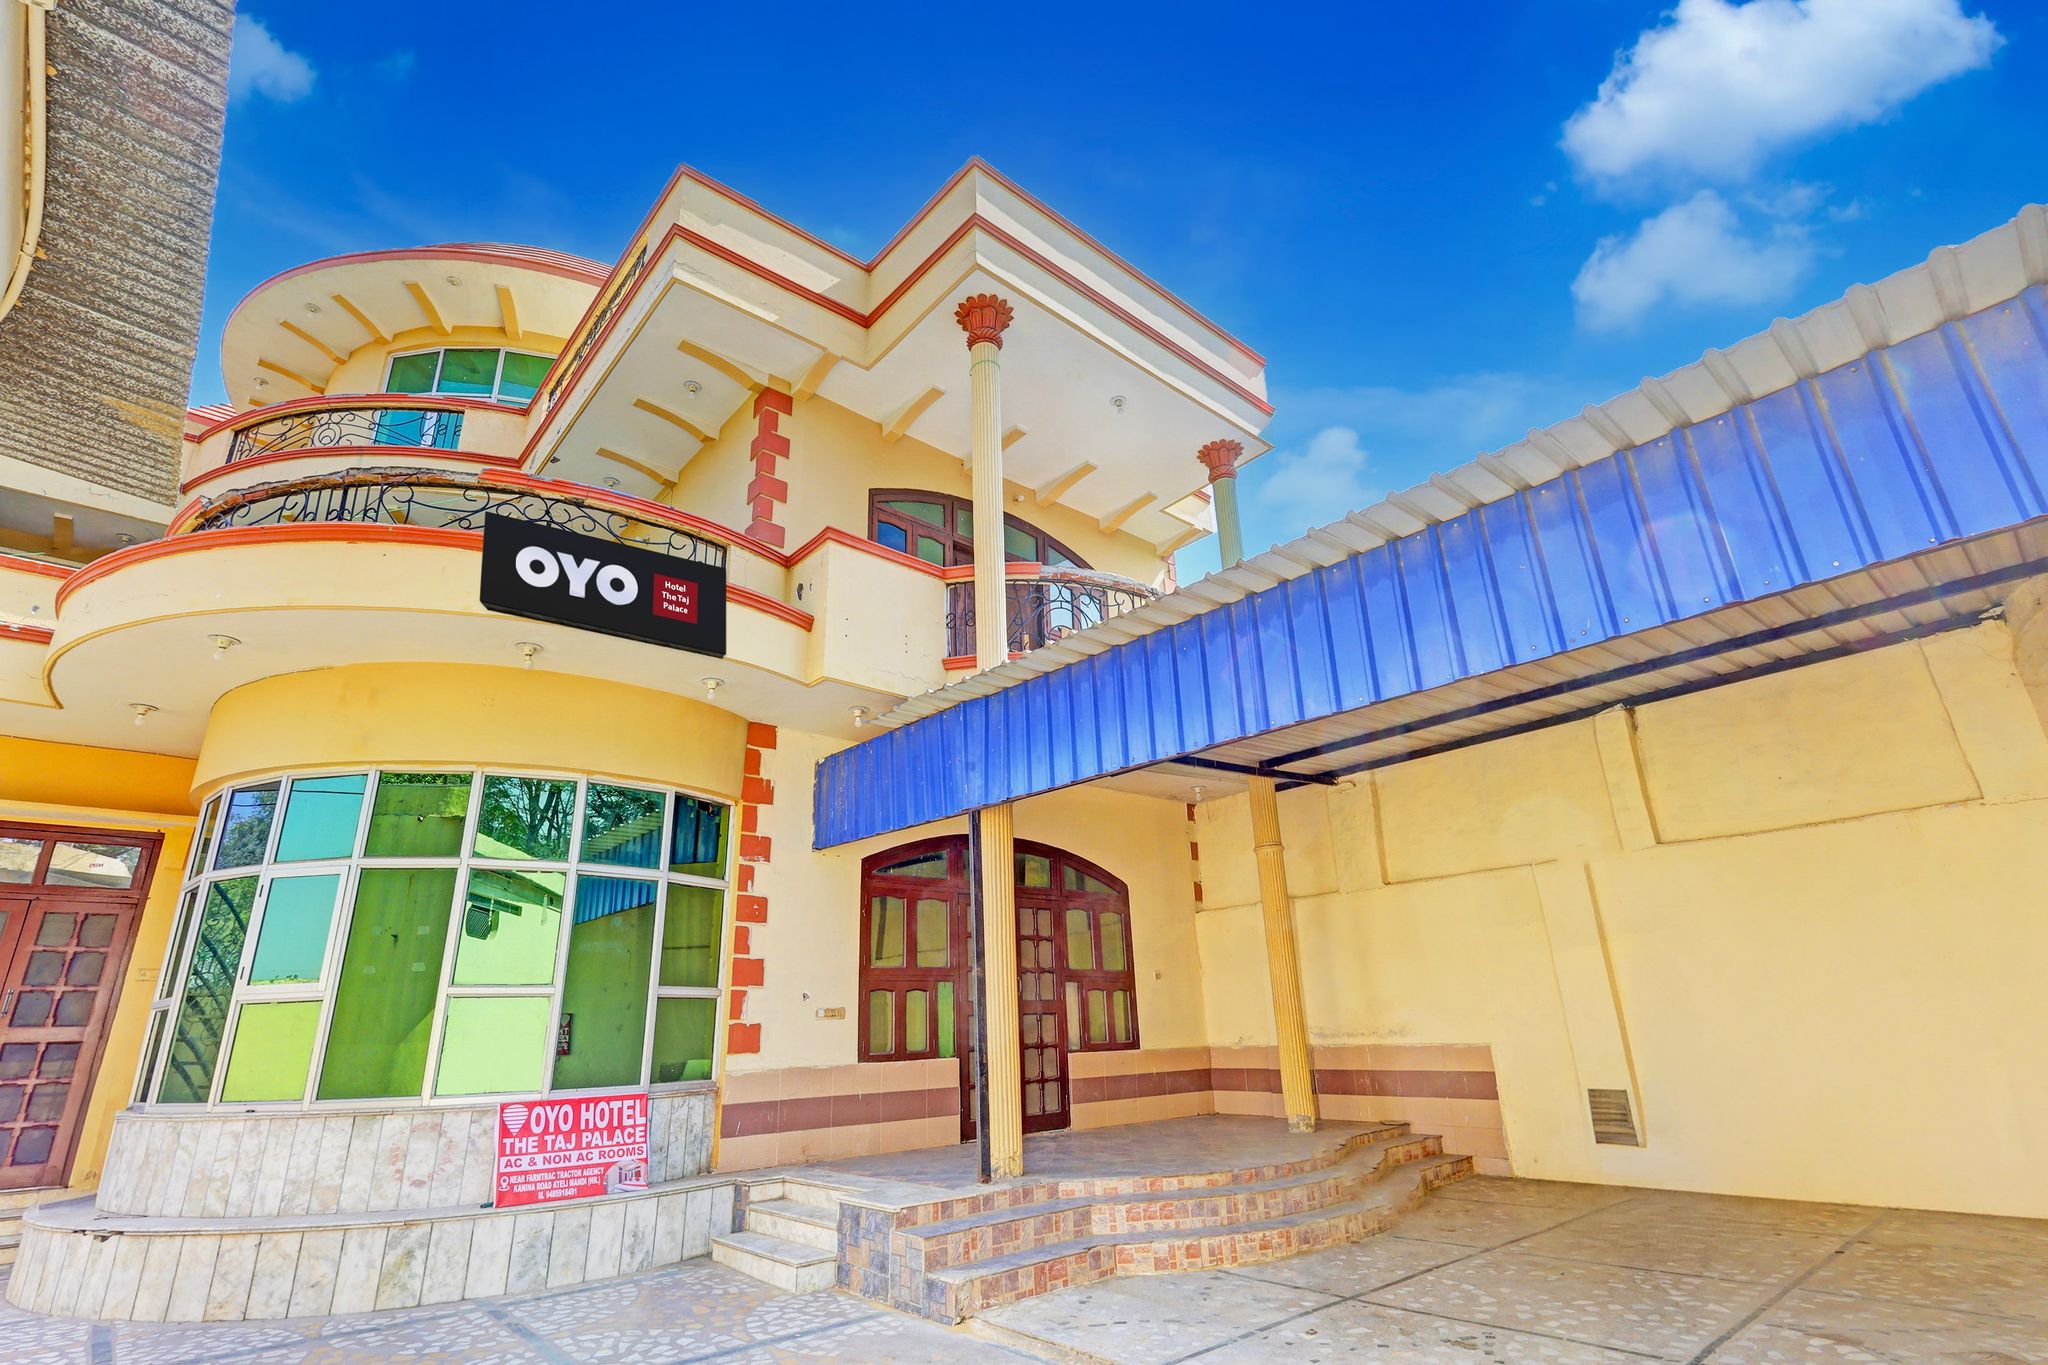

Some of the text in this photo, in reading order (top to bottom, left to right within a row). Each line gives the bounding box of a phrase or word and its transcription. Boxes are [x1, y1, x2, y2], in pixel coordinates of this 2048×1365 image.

[515, 546, 639, 605] OYO
[665, 581, 686, 592] Hotel
[662, 590, 689, 605] The Taj
[663, 602, 688, 614] Palace
[530, 1100, 646, 1134] OYO HOTEL
[503, 1127, 645, 1155] THE TAJ PALACE
[504, 1146, 644, 1169] AC & NON AC ROOMS
[509, 1167, 605, 1184] NEAR FARMTRAC TRACTOR AGENCY
[536, 1180, 552, 1190] ROAD
